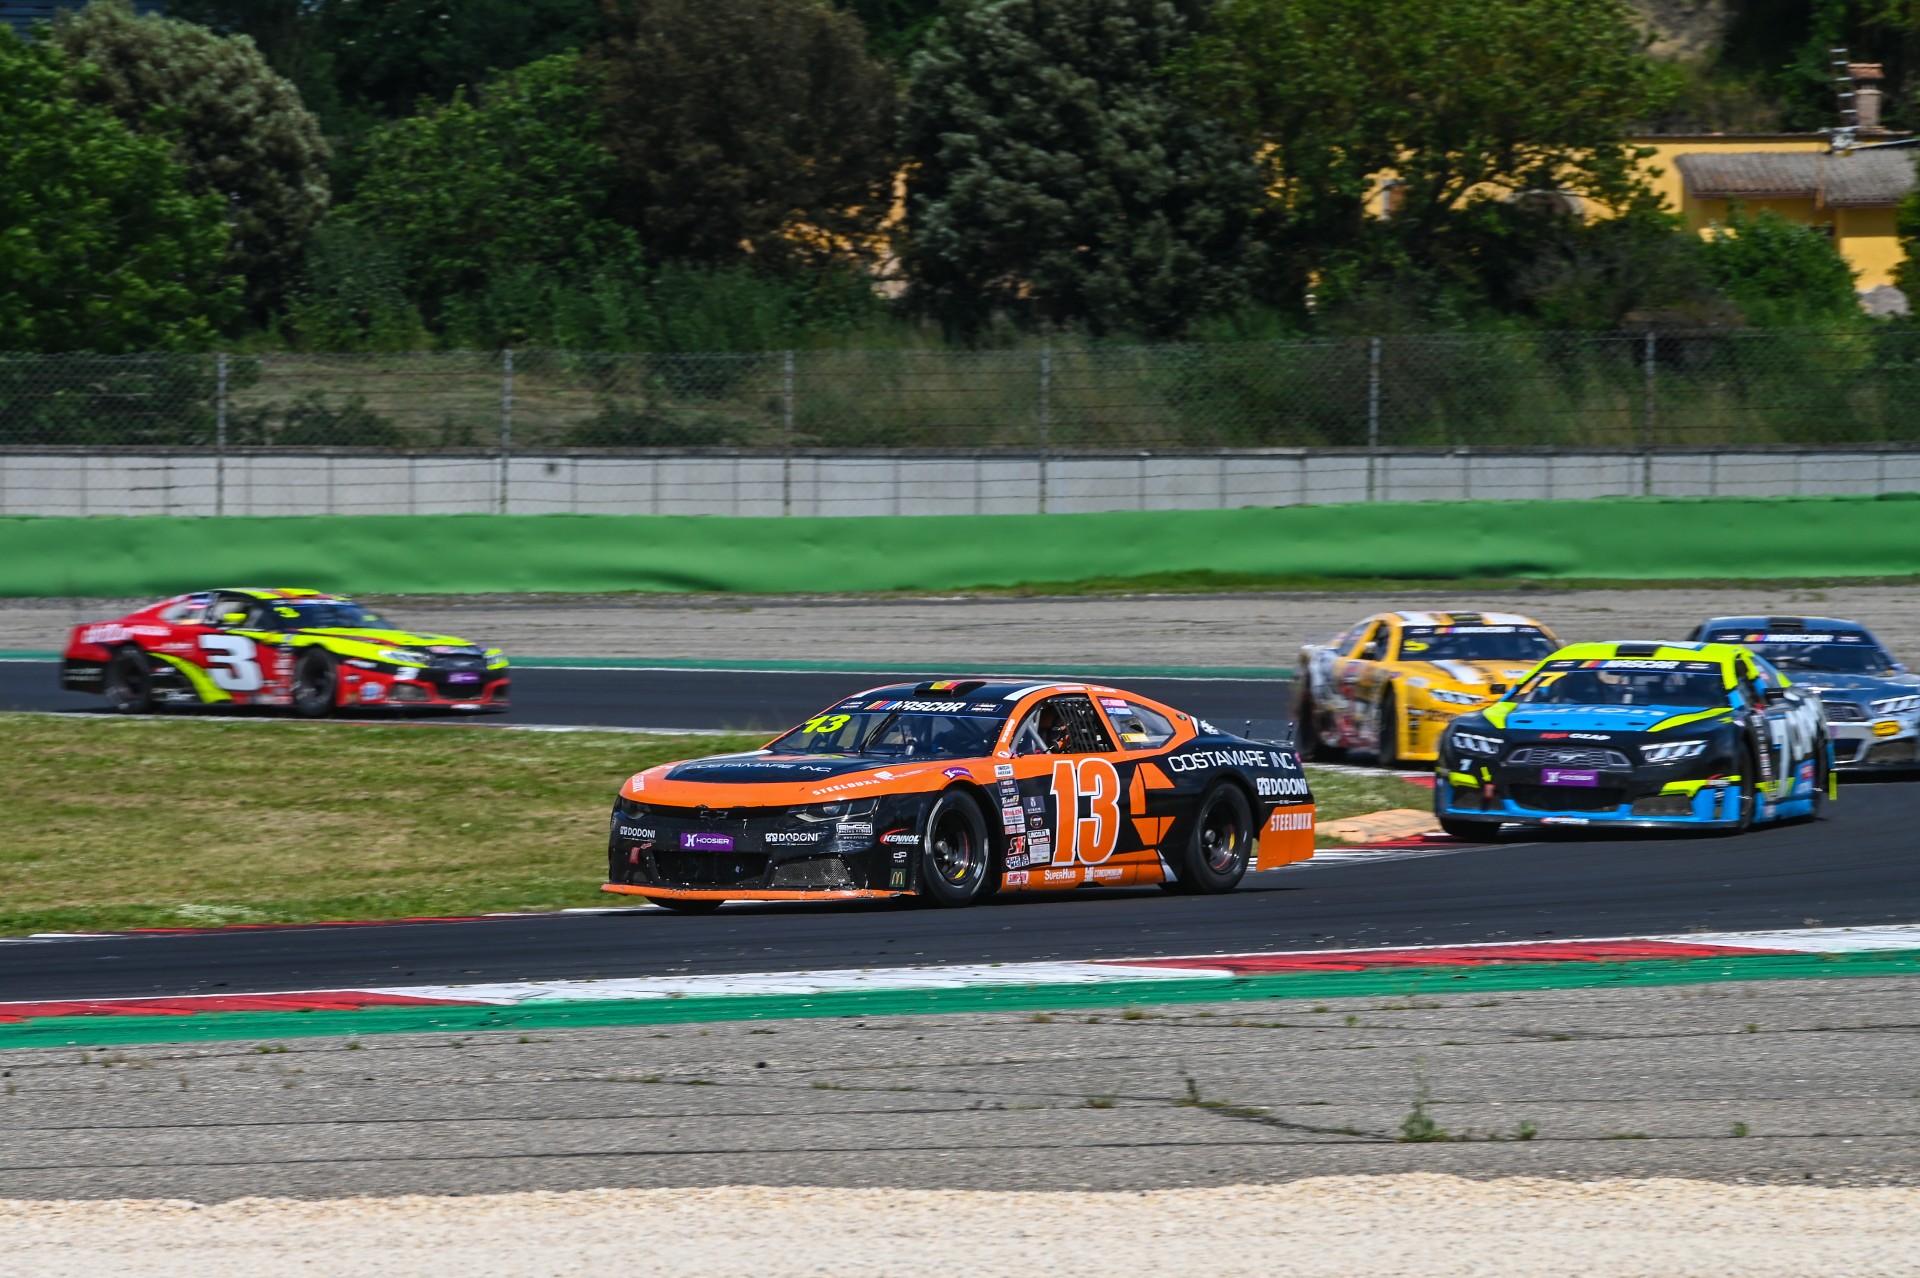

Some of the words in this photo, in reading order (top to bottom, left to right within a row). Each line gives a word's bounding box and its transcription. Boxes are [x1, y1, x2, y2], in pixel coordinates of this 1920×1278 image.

[274, 607, 300, 618] 3
[199, 635, 263, 691] 3
[887, 701, 966, 712] NASCAR
[802, 715, 851, 734] 13
[1168, 750, 1268, 772] COSTAMARE
[1270, 752, 1297, 769] INC.
[1271, 778, 1308, 795] DODONI
[1050, 757, 1120, 866] 13
[627, 827, 656, 838] DODONI
[779, 833, 820, 842] DODONI
[696, 837, 730, 845] HOOSIER
